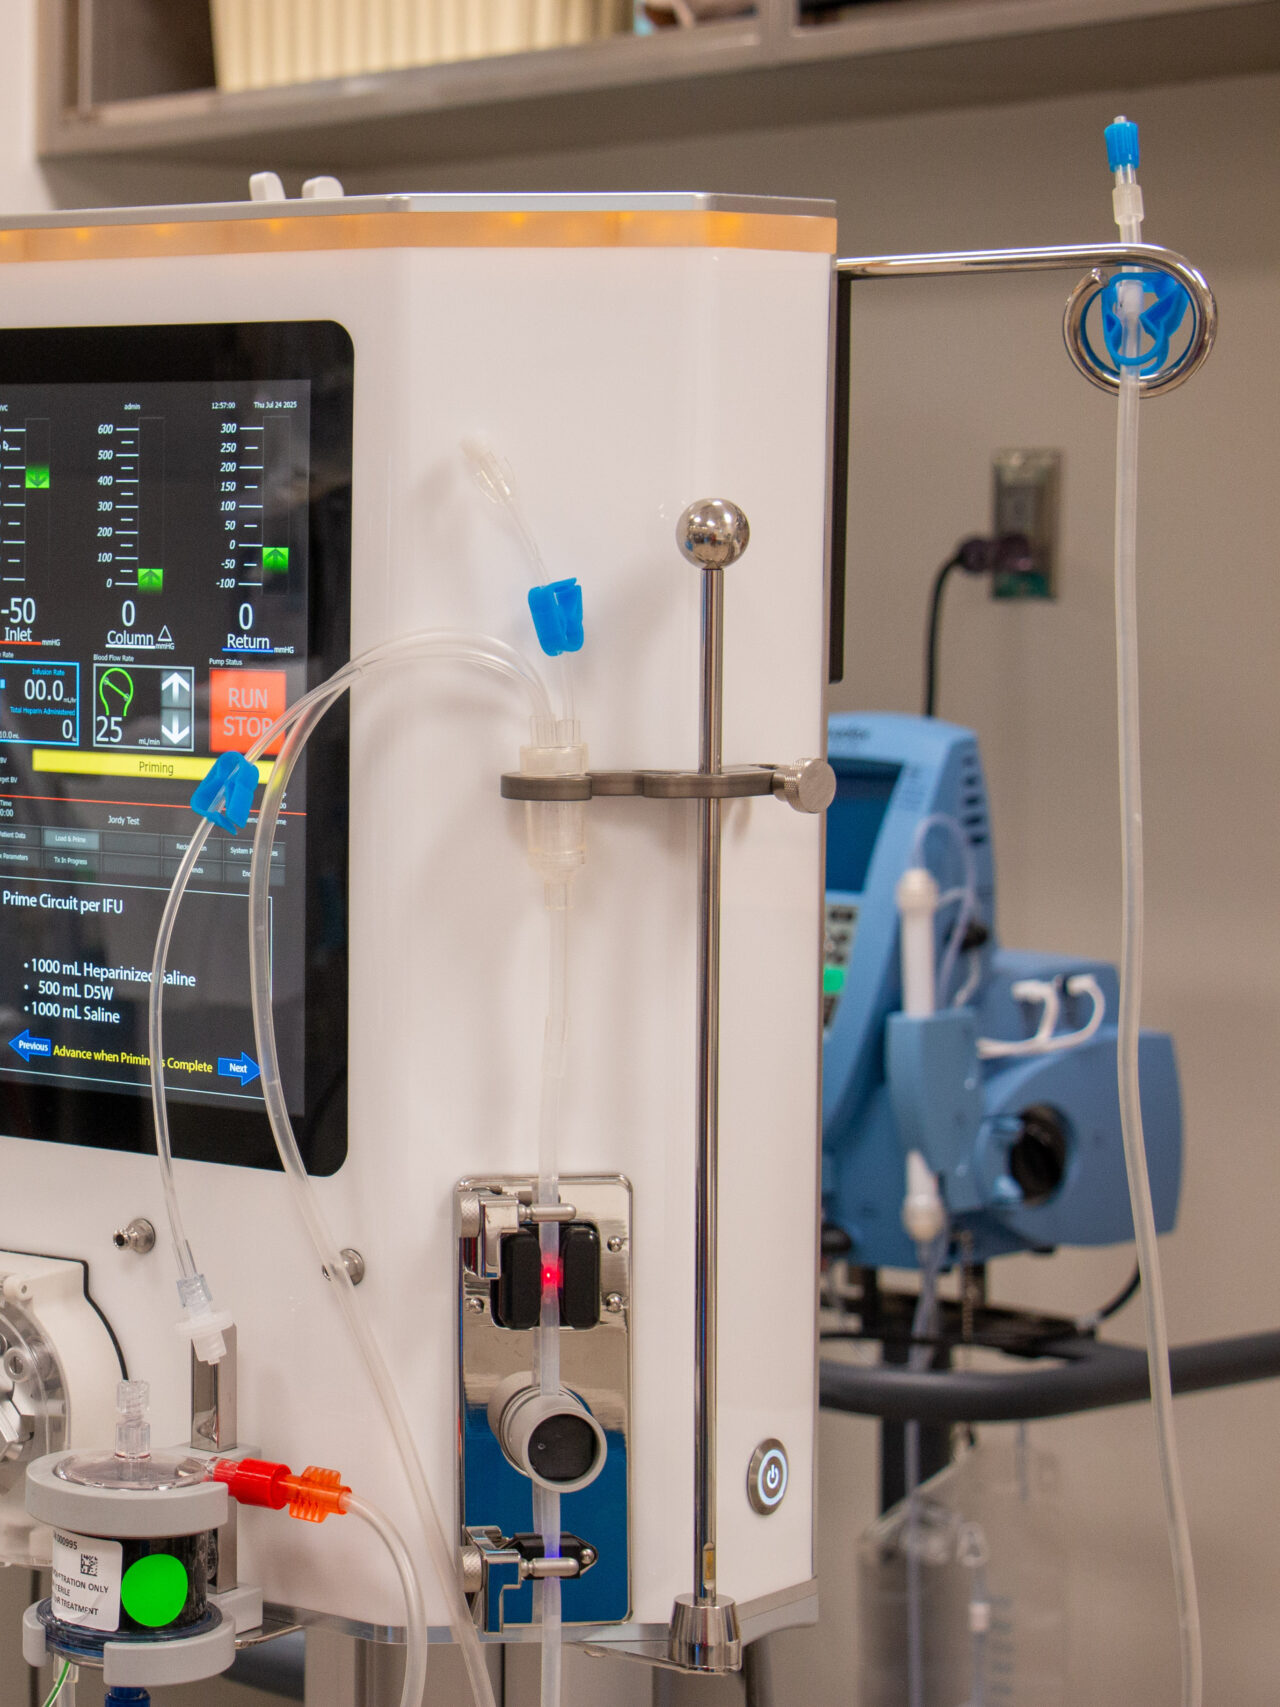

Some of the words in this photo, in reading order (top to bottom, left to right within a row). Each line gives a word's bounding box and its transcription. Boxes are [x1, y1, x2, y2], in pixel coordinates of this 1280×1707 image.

[98, 424, 113, 434] 600
[221, 423, 236, 433] 300
[221, 443, 236, 453] 250
[98, 450, 113, 460] 500
[220, 462, 236, 472] 200
[97, 476, 113, 486] 400
[221, 482, 236, 492] 150
[97, 502, 113, 511] 300
[221, 501, 236, 511] 100
[97, 527, 113, 537] 200
[225, 521, 235, 531] 50
[229, 540, 235, 550] 0
[97, 553, 112, 563] 100
[221, 560, 235, 569] -50
[106, 579, 112, 588] 0
[216, 578, 235, 588] -100
[0, 598, 36, 624] -50
[122, 600, 135, 627] 0
[239, 603, 253, 630] 0
[4, 627, 32, 641] Inlet
[107, 630, 154, 646] Column
[227, 634, 270, 649] Return
[24, 679, 63, 701] 00.0
[228, 688, 268, 709] RUN
[62, 719, 72, 739] 0
[96, 716, 122, 743] 25
[223, 716, 273, 737] STOP
[139, 762, 174, 775] Priming
[108, 816, 125, 826] Jordy
[126, 817, 140, 825] Test
[3, 891, 37, 906] Prime
[40, 893, 78, 910] Circuit
[80, 900, 100, 915] per
[103, 898, 123, 914] IFU
[32, 958, 60, 974] 1000
[63, 961, 81, 976] mL
[38, 981, 60, 996] 500
[63, 982, 81, 998] mL
[84, 985, 114, 1000] D5W
[32, 1002, 60, 1018] 1000
[63, 1004, 81, 1020] mL
[84, 1006, 120, 1023] Saline
[19, 1040, 48, 1052] Previous
[53, 1046, 92, 1062] Advance
[94, 1049, 119, 1064] when
[121, 1052, 151, 1067] Primin
[167, 1058, 213, 1073] Complete
[229, 1062, 247, 1074] Next
[88, 1584, 109, 1593] ONLY
[61, 1599, 99, 1615] TREATMENT
